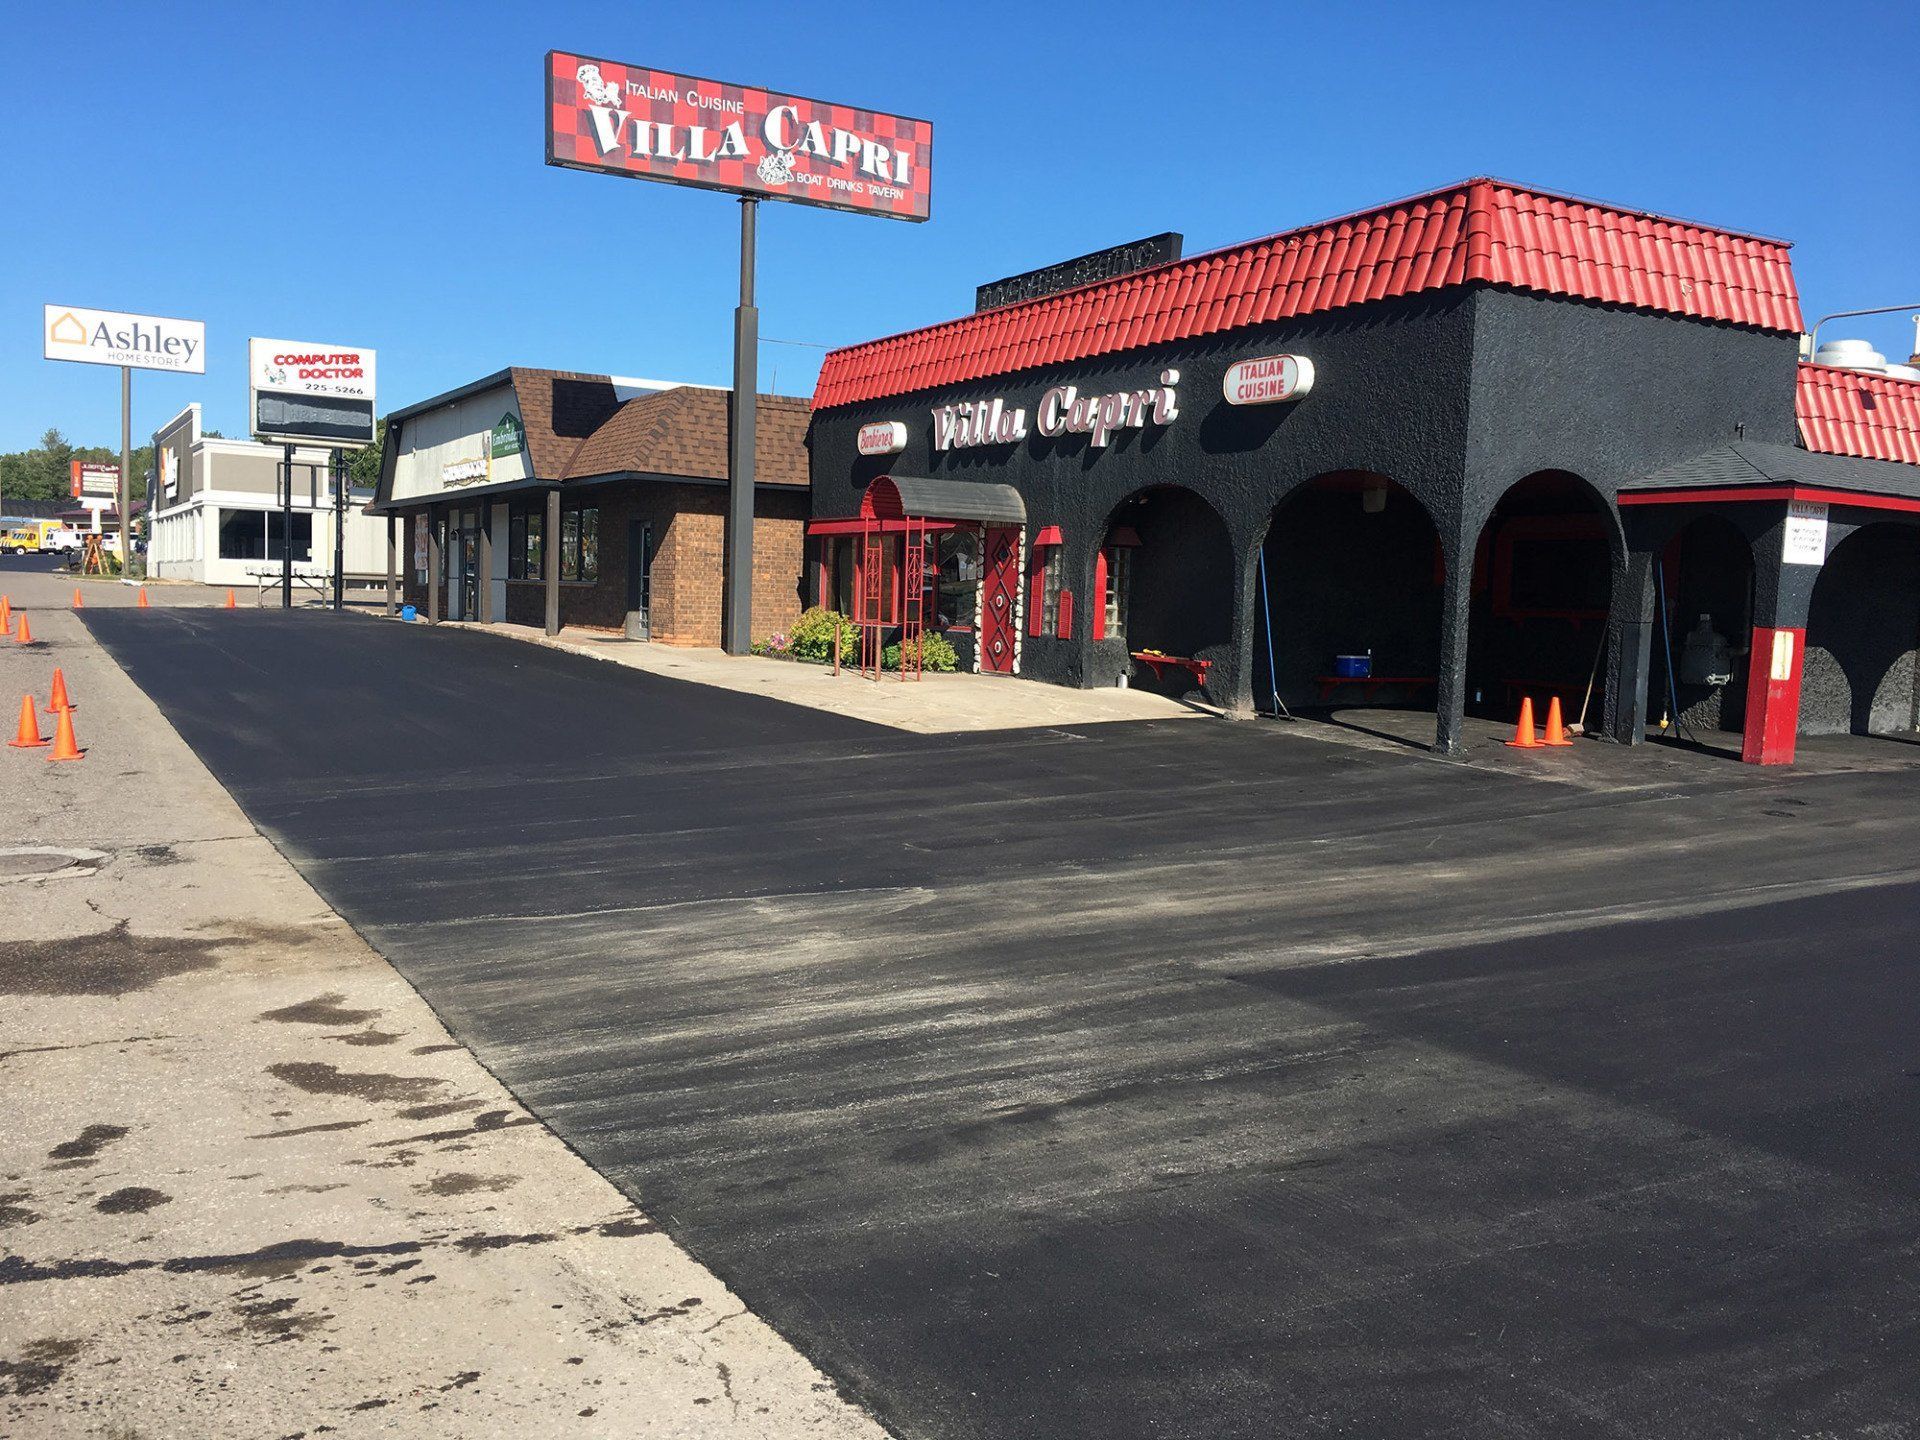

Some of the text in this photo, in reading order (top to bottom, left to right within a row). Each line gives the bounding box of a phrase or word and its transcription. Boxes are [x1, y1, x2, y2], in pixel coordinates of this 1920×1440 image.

[625, 79, 744, 115] ITALIAN CUISINE
[588, 103, 910, 185] VILLA CAPRI
[796, 172, 904, 199] BOAT DRINKS TAVERN
[90, 320, 199, 364] Ashley
[273, 353, 360, 366] COMPUTER
[1239, 360, 1285, 381] ITALIAN
[298, 367, 364, 379] DOCTOR
[305, 382, 364, 395] 225-5266
[1237, 379, 1285, 399] CUISINE
[931, 368, 1181, 451] Villa Capri
